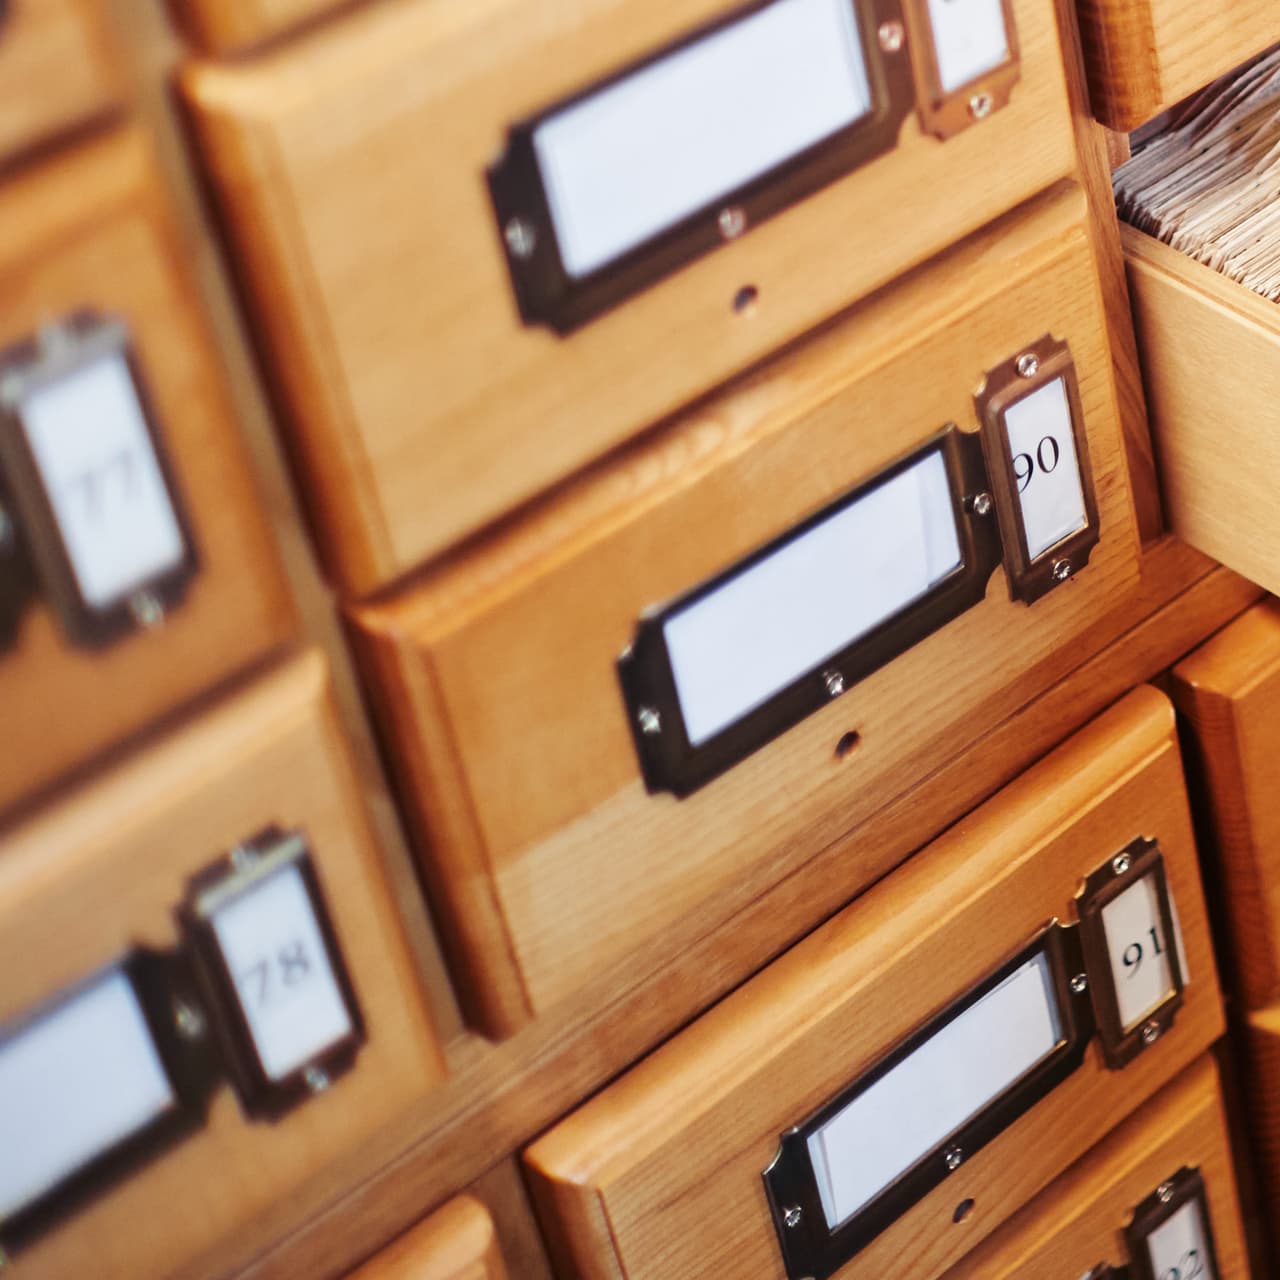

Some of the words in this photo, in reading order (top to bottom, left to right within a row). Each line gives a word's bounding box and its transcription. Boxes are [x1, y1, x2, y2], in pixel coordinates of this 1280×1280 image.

[1012, 435, 1060, 494] 90
[241, 939, 312, 1008] 78
[1122, 926, 1164, 980] 91
